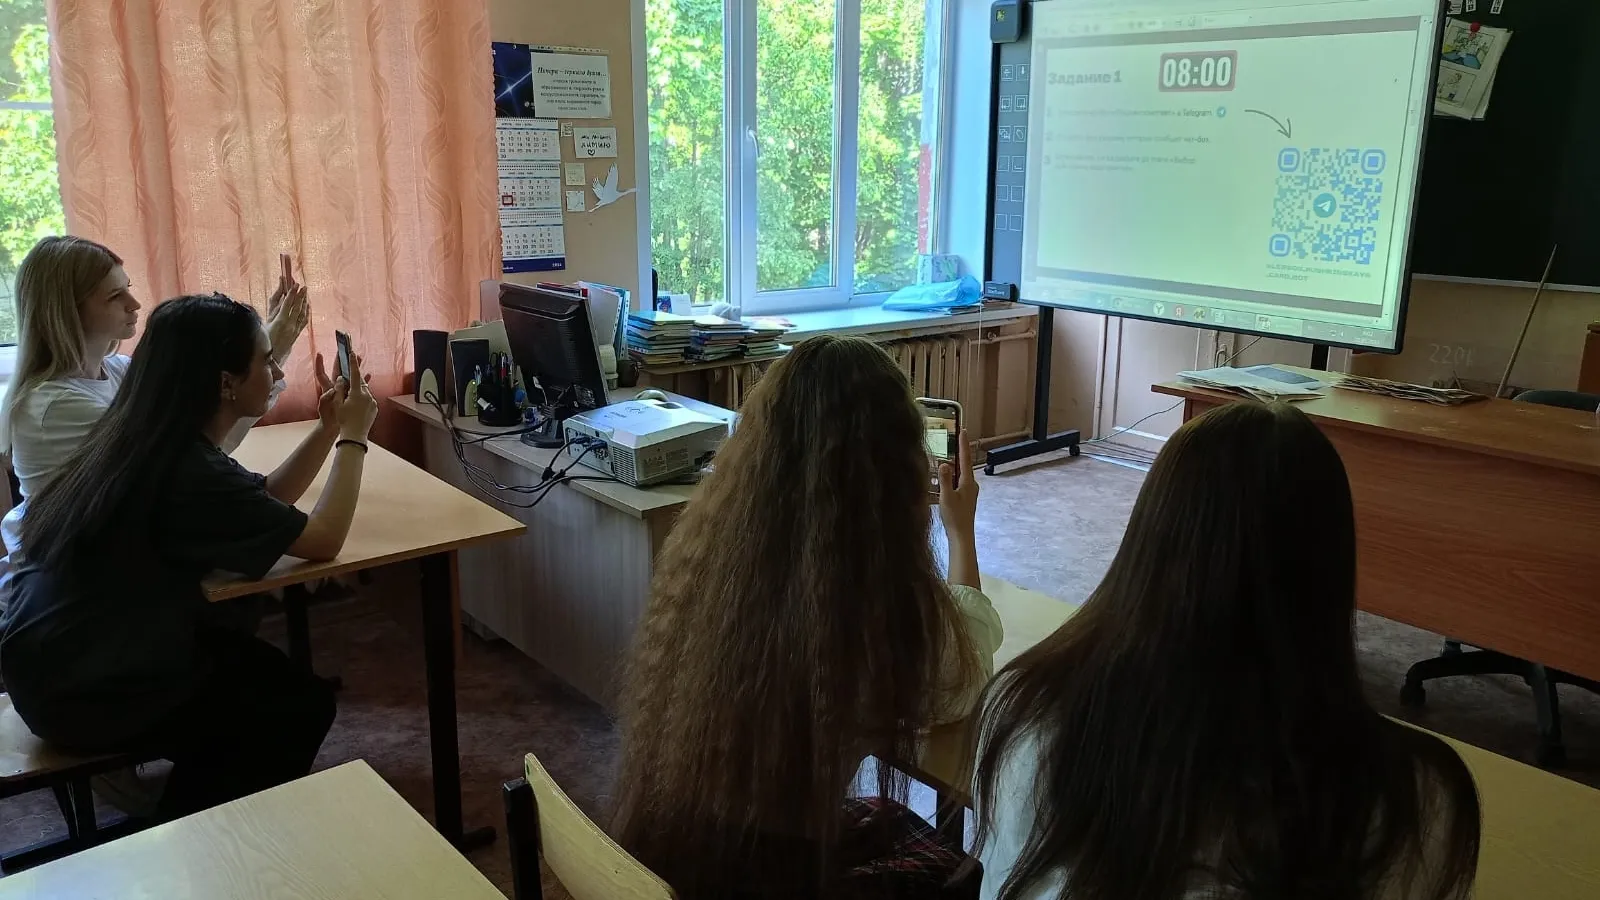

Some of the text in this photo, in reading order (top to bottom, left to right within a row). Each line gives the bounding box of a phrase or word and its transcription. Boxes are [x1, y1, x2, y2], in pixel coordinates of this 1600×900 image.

[1048, 70, 1122, 86] Задание 1
[1163, 56, 1232, 87] 08:00
[1182, 108, 1212, 118] Telegram
